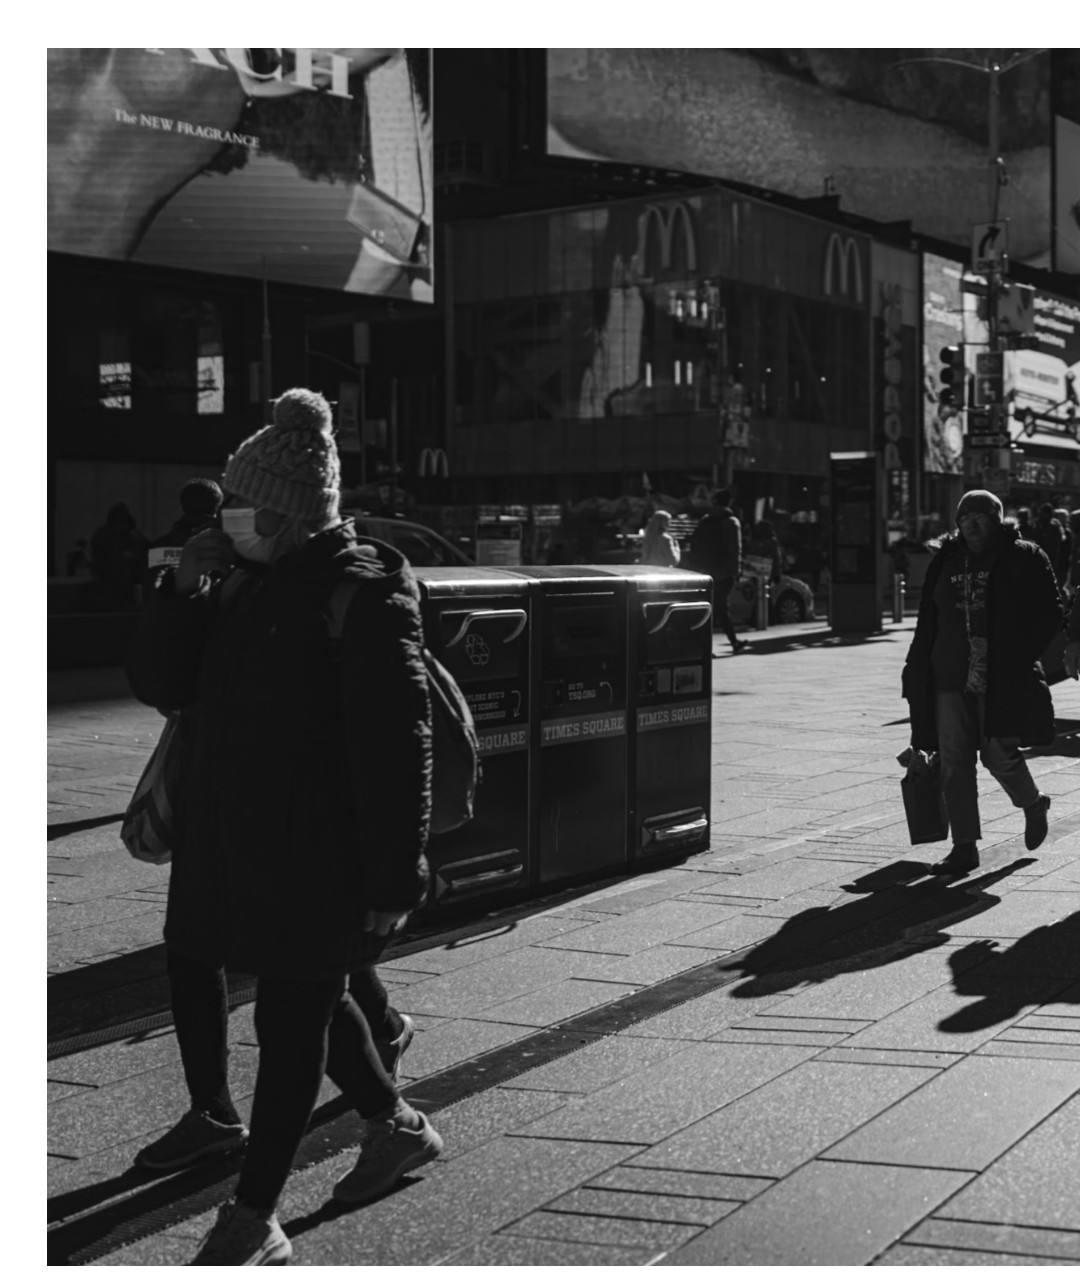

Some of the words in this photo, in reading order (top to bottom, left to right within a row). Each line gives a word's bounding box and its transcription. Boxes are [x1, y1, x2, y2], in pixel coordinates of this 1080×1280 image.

[113, 108, 138, 127] The
[139, 114, 176, 135] NEW
[177, 119, 261, 150] FRAGRANCE
[638, 710, 670, 727] TIMES
[671, 704, 709, 722] SQUARE
[543, 722, 581, 741] TIMES
[582, 716, 625, 735] SQUARE
[476, 731, 526, 751] SQUARE
